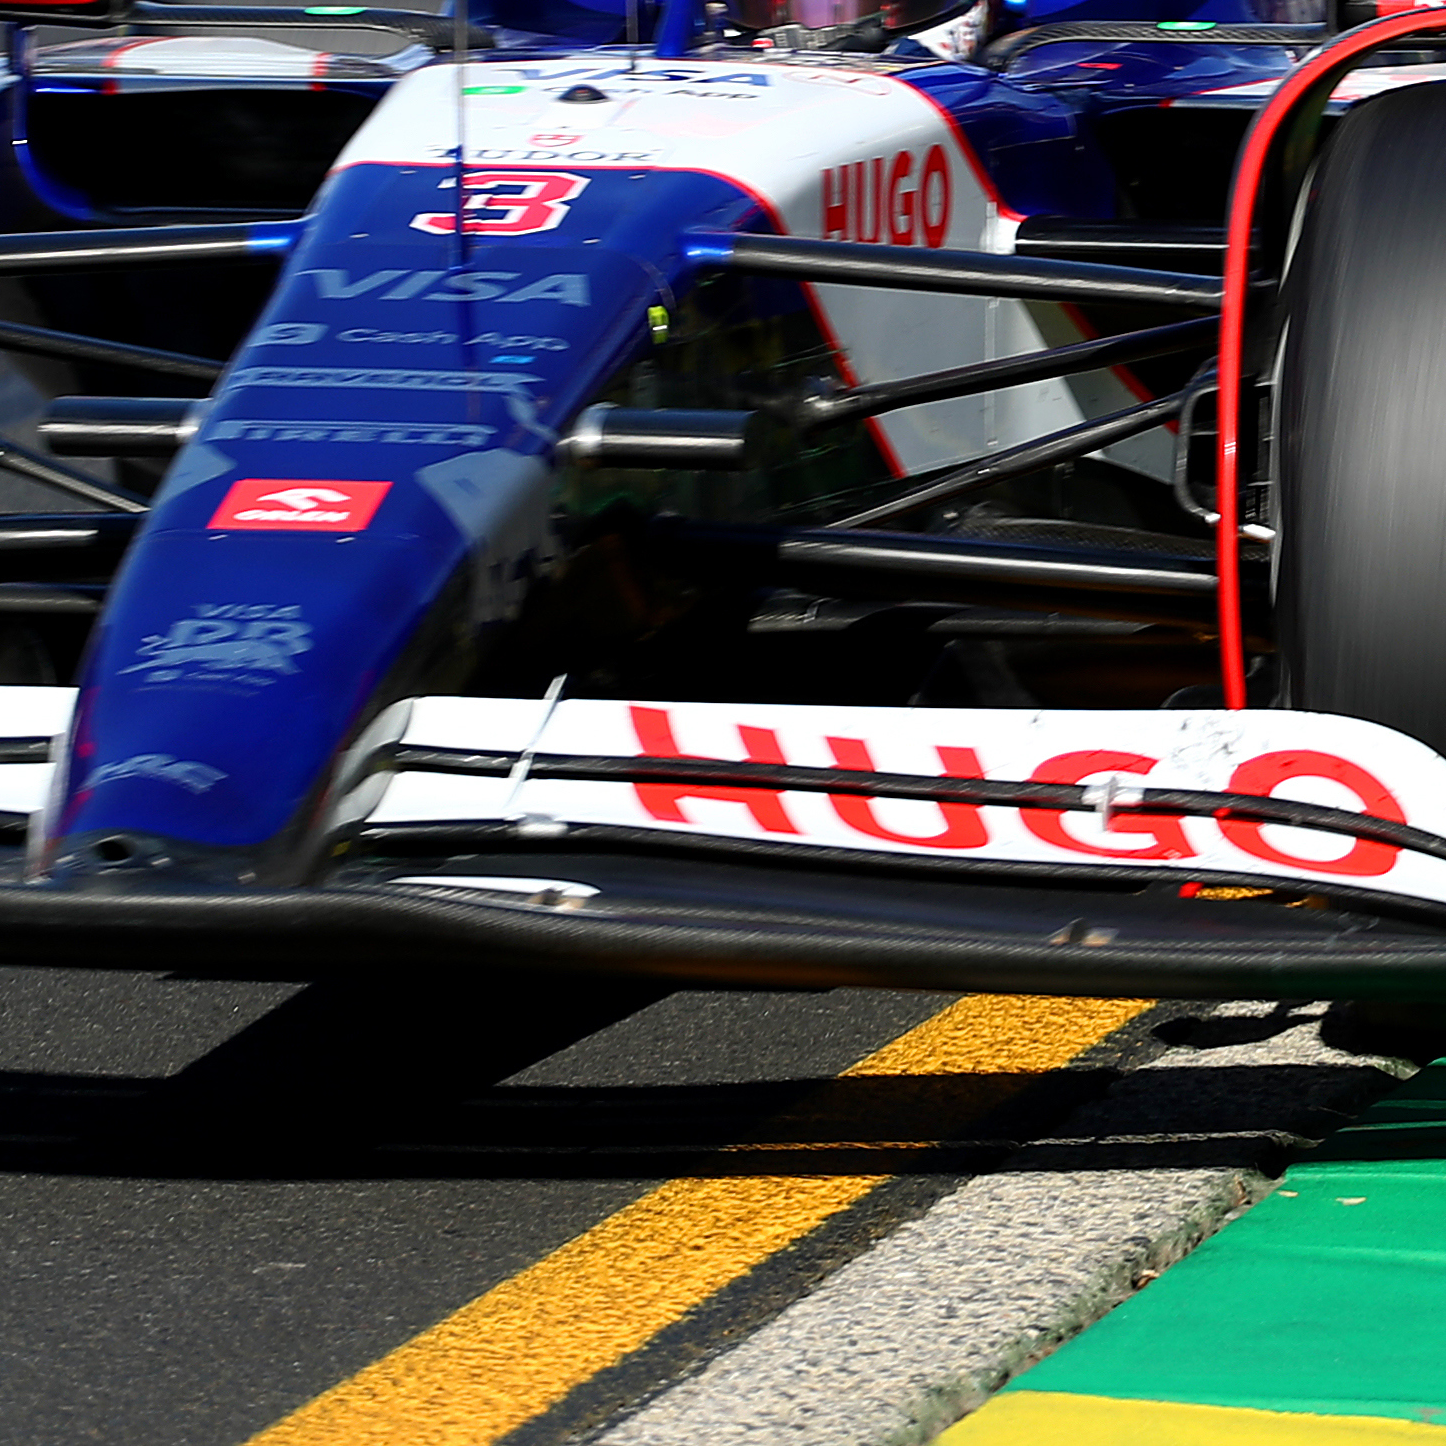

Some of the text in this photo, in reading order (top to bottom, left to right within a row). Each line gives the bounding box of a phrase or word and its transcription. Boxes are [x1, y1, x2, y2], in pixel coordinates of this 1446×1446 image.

[492, 68, 773, 87] VISA
[426, 146, 664, 163] TUDOR
[409, 171, 592, 236] 3
[820, 143, 951, 249] HUGO
[292, 268, 591, 307] VISA
[336, 328, 570, 352] Cash App
[204, 420, 498, 446] PIRELLI
[233, 509, 351, 523] ORLEN
[628, 705, 1409, 878] HUGO
